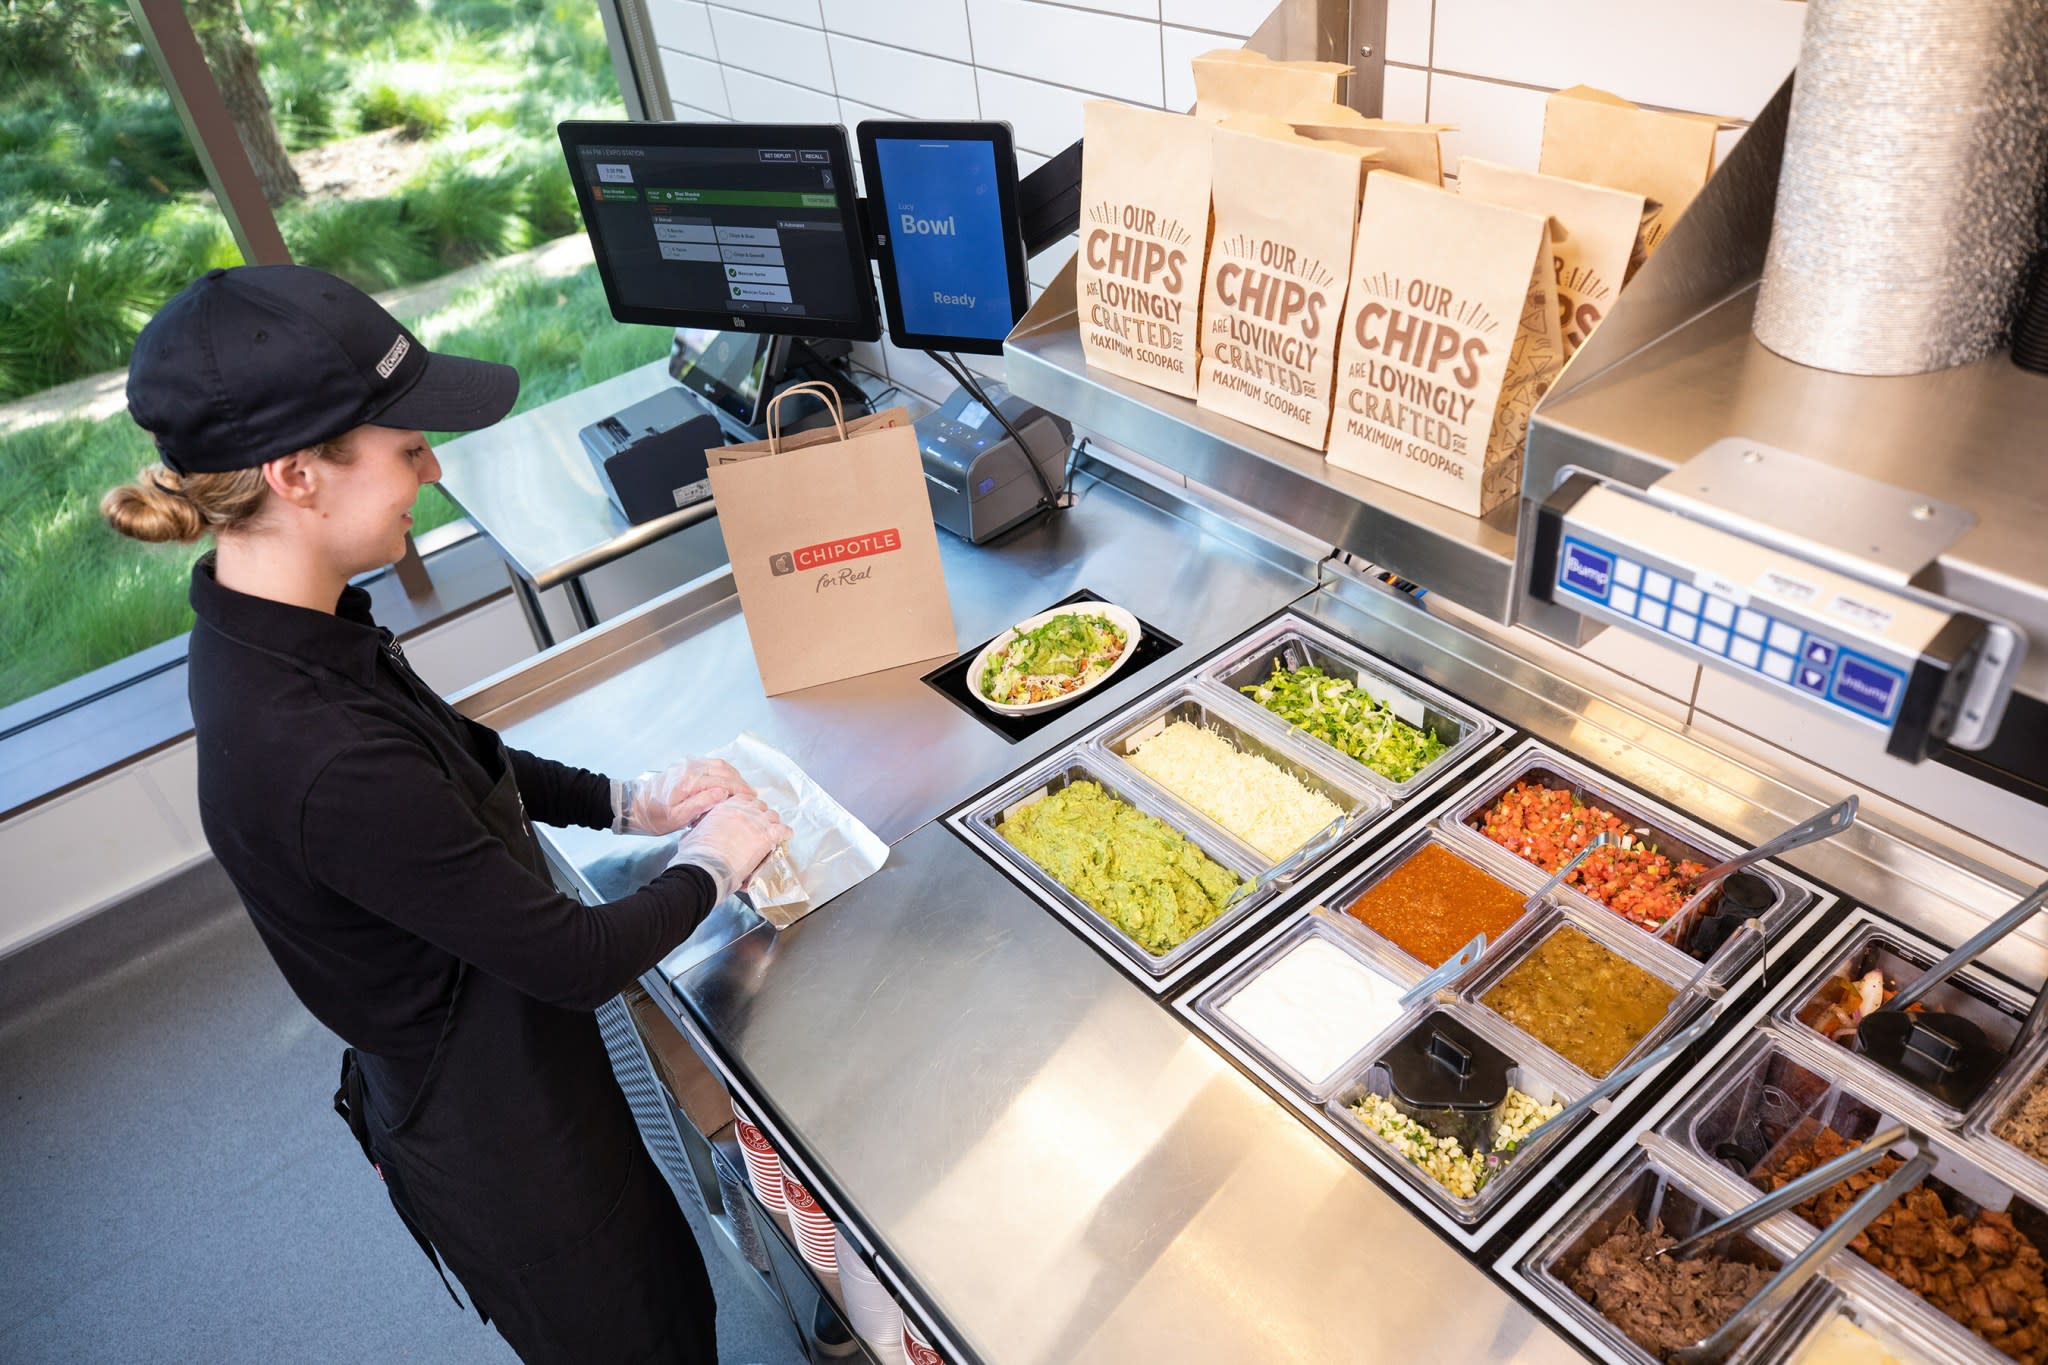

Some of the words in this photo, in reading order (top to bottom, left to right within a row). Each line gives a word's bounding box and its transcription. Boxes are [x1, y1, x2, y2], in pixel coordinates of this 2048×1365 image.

[901, 214, 956, 236] Bowl
[1123, 205, 1156, 236] OUR
[1086, 228, 1187, 294] CHIPS
[1260, 240, 1296, 275] OUR
[933, 291, 976, 308] Ready
[1086, 282, 1099, 297] ARE
[1099, 278, 1182, 324] LOVINGLY
[1216, 262, 1327, 339] CHIPS
[1408, 279, 1453, 317] OUR
[1091, 304, 1172, 350] CRAFTED
[1212, 319, 1228, 334] ARE
[1229, 315, 1318, 373] LOVINGLY
[1355, 302, 1489, 389] CHIPS
[1090, 332, 1134, 360] MAXIMUM
[1136, 348, 1185, 374] SCOOPAGE
[1214, 343, 1303, 396] CRAFTED
[1212, 369, 1261, 400] MAXIMUM
[1264, 391, 1311, 425] SCOOPAGE
[1349, 362, 1367, 378] ARE
[1368, 359, 1475, 425] LOVINGLY
[1349, 388, 1451, 450] CRAFTED
[1347, 419, 1403, 454] MAXIMUM
[1405, 443, 1464, 480] SCOOPAGE
[800, 533, 896, 565] CHIPOTLE
[1568, 556, 1609, 585] Bump
[816, 573, 838, 593] for
[838, 565, 872, 586] Real
